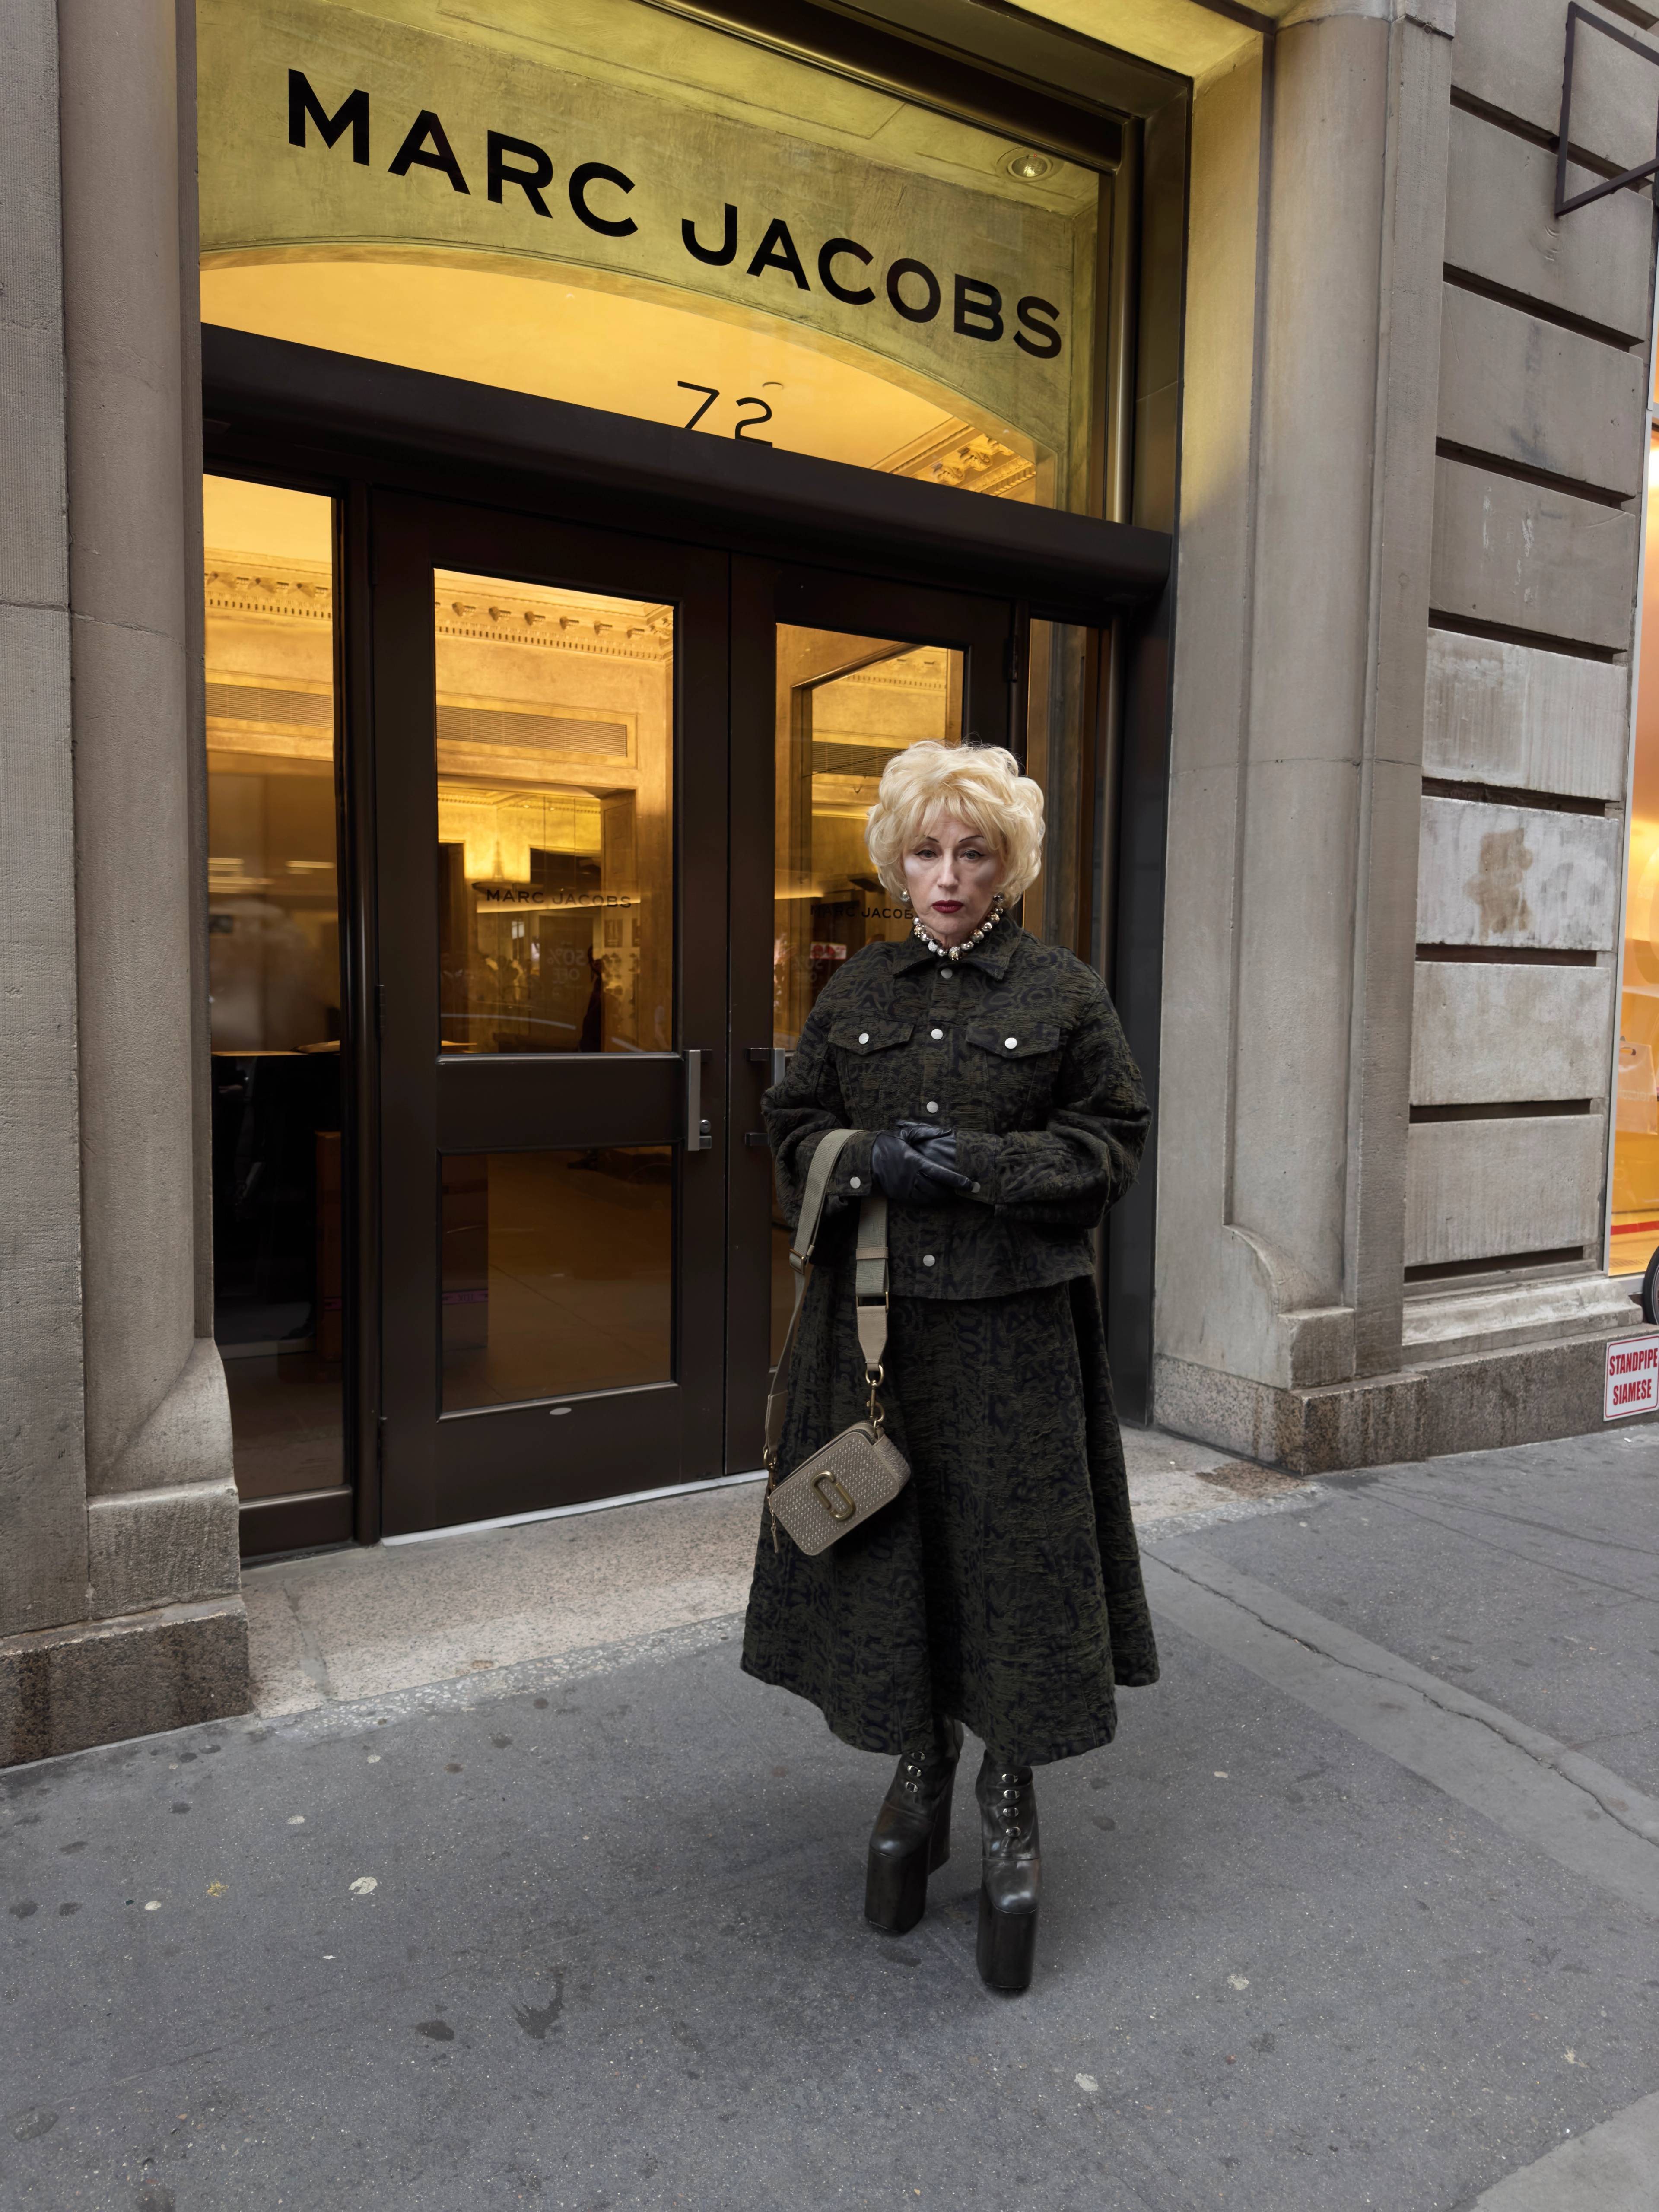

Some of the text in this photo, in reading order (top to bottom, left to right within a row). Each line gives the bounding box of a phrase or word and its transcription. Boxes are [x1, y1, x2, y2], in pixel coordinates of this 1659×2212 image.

[289, 69, 1062, 359] MARC JACOBS
[677, 380, 773, 448] 72
[486, 889, 632, 908] MARC JACOBS
[810, 904, 913, 919] MARC JACOB
[1609, 1348, 1658, 1376] STANDPIPE
[1613, 1379, 1652, 1406] SIAMESE
